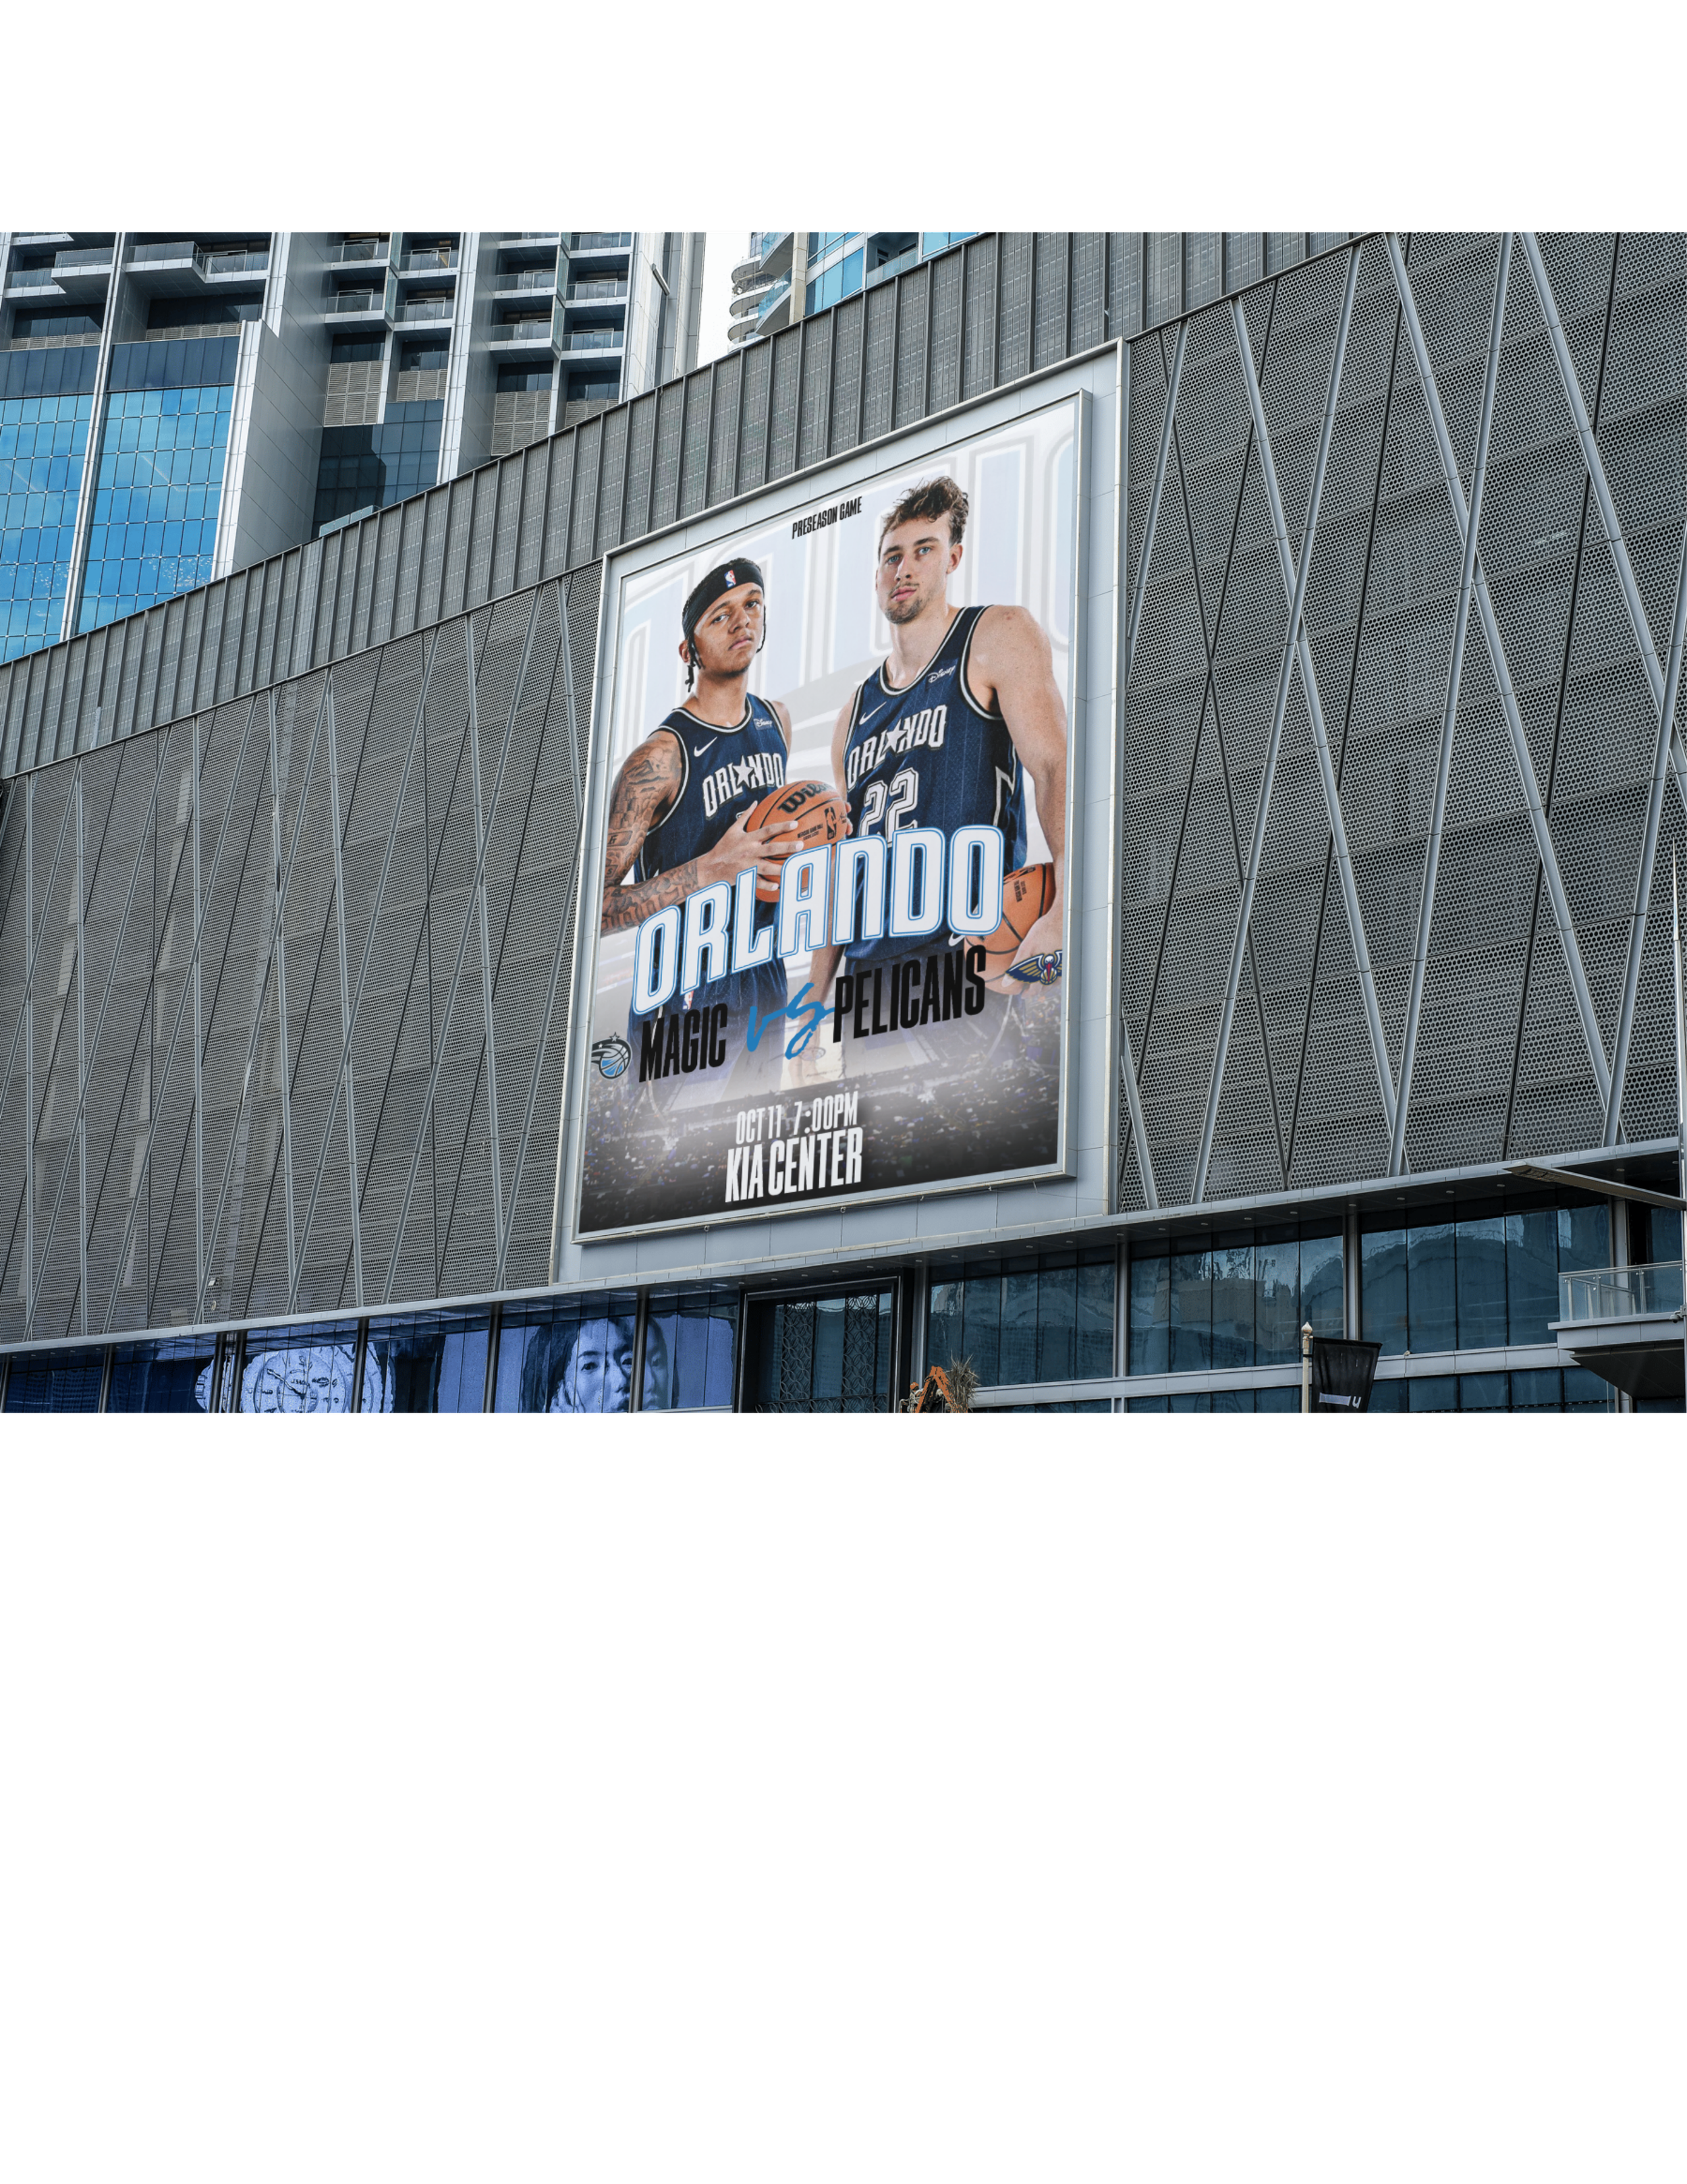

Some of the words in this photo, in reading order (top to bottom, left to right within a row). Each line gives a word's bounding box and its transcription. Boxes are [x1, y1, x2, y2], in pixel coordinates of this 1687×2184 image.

[792, 506, 838, 540] PRESEASON
[839, 495, 862, 520] GAME
[632, 824, 1004, 1015] ORLANDO
[639, 1004, 728, 1083] MAGIC
[833, 945, 987, 1043] PELICANS
[736, 1108, 766, 1145] OCT
[767, 1104, 783, 1139] 11
[793, 1091, 858, 1136] 7:00PM
[725, 1143, 765, 1203] KIA
[768, 1126, 864, 1197] CENTER
